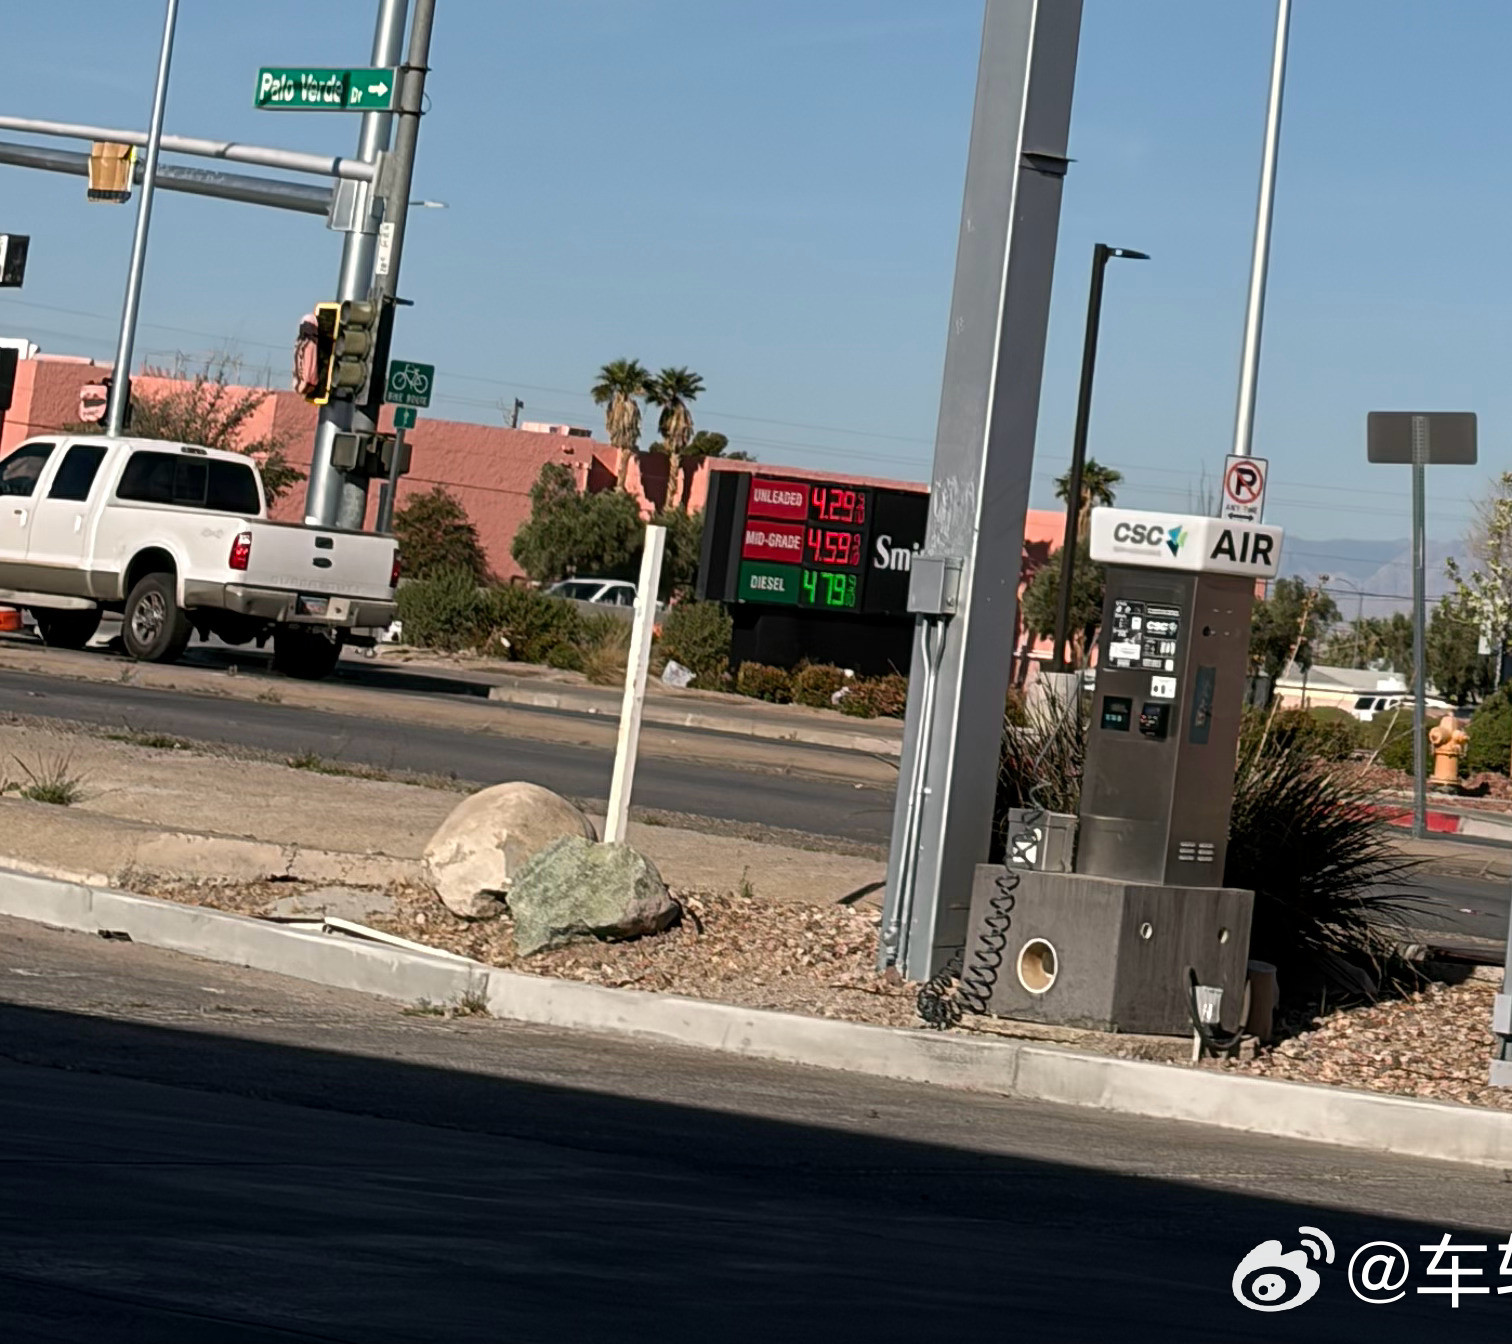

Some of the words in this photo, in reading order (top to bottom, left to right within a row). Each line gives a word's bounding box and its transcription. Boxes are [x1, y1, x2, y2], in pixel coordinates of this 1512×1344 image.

[259, 72, 295, 102] Palo
[300, 73, 344, 103] Verde
[350, 86, 363, 104] Dr
[754, 488, 803, 507] UNLEADED
[812, 487, 856, 523] 4.29
[745, 529, 802, 551] MID-GRADE
[807, 527, 851, 565] 4.59
[1113, 522, 1165, 546] CSC
[1210, 529, 1274, 567] AIR
[750, 574, 786, 593] DIESEL
